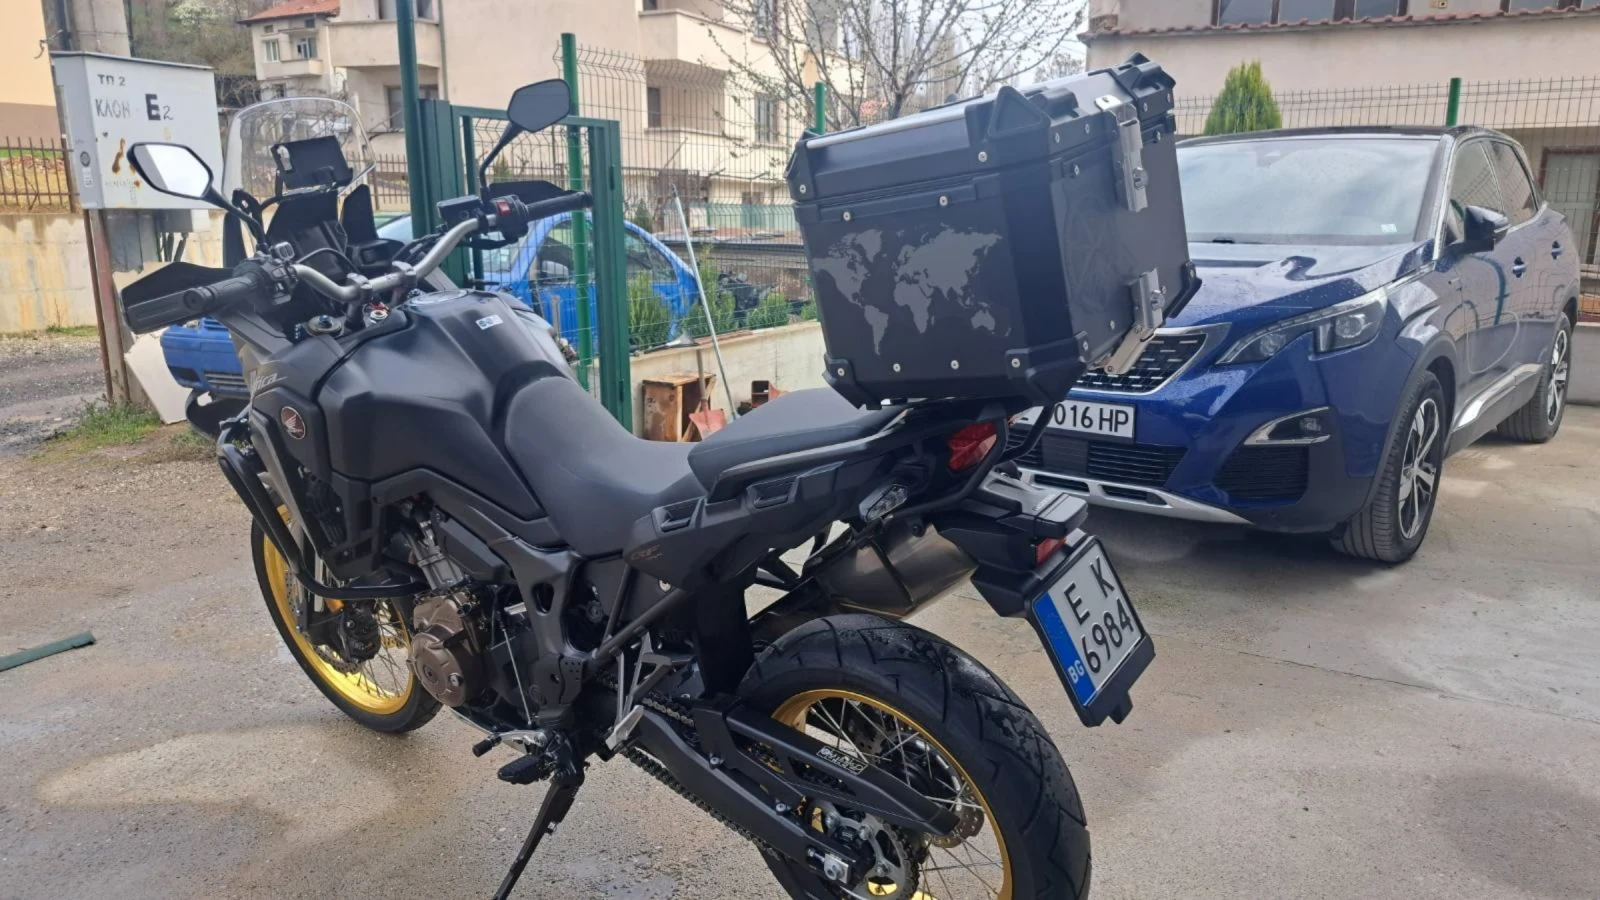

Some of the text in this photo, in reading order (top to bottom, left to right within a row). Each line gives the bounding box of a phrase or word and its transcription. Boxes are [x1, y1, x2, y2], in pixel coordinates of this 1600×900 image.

[97, 73, 127, 87] ТП 2
[1063, 556, 1116, 626] E K
[1080, 598, 1135, 674] 6984
[1067, 659, 1085, 685] BG
